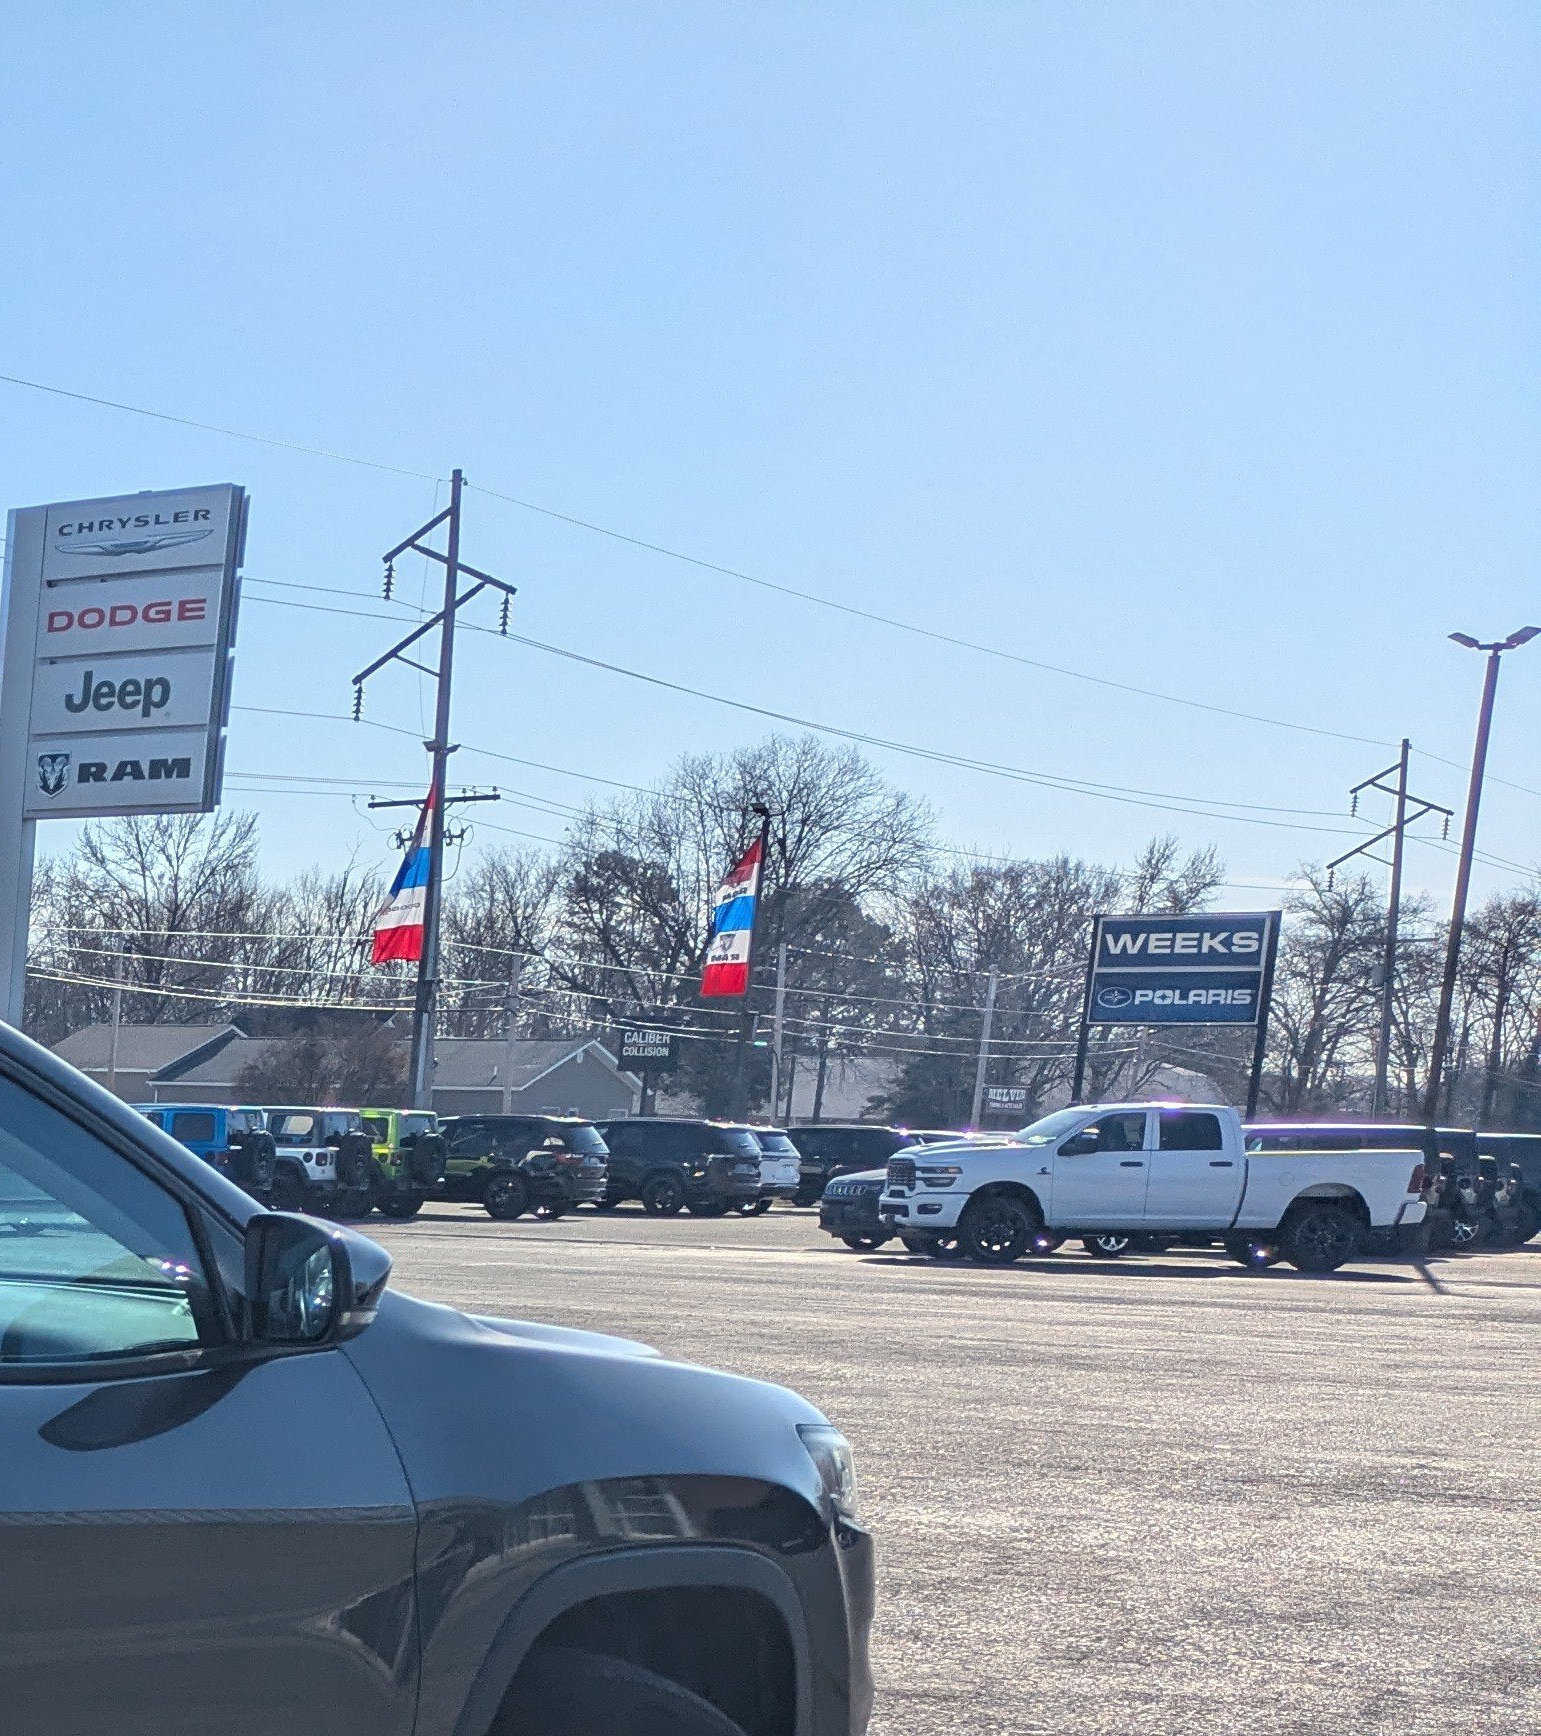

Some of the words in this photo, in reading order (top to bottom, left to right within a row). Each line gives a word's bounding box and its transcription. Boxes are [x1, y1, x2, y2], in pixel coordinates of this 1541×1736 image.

[57, 507, 212, 538] CHRYSLER
[46, 598, 207, 634] DODGE
[64, 670, 171, 718] Jeep
[77, 757, 192, 784] RAM
[1104, 931, 1260, 955] WEEKS
[1134, 989, 1253, 1006] POLARIS
[624, 1031, 670, 1044] CALIBER
[622, 1046, 670, 1057] COLLISION
